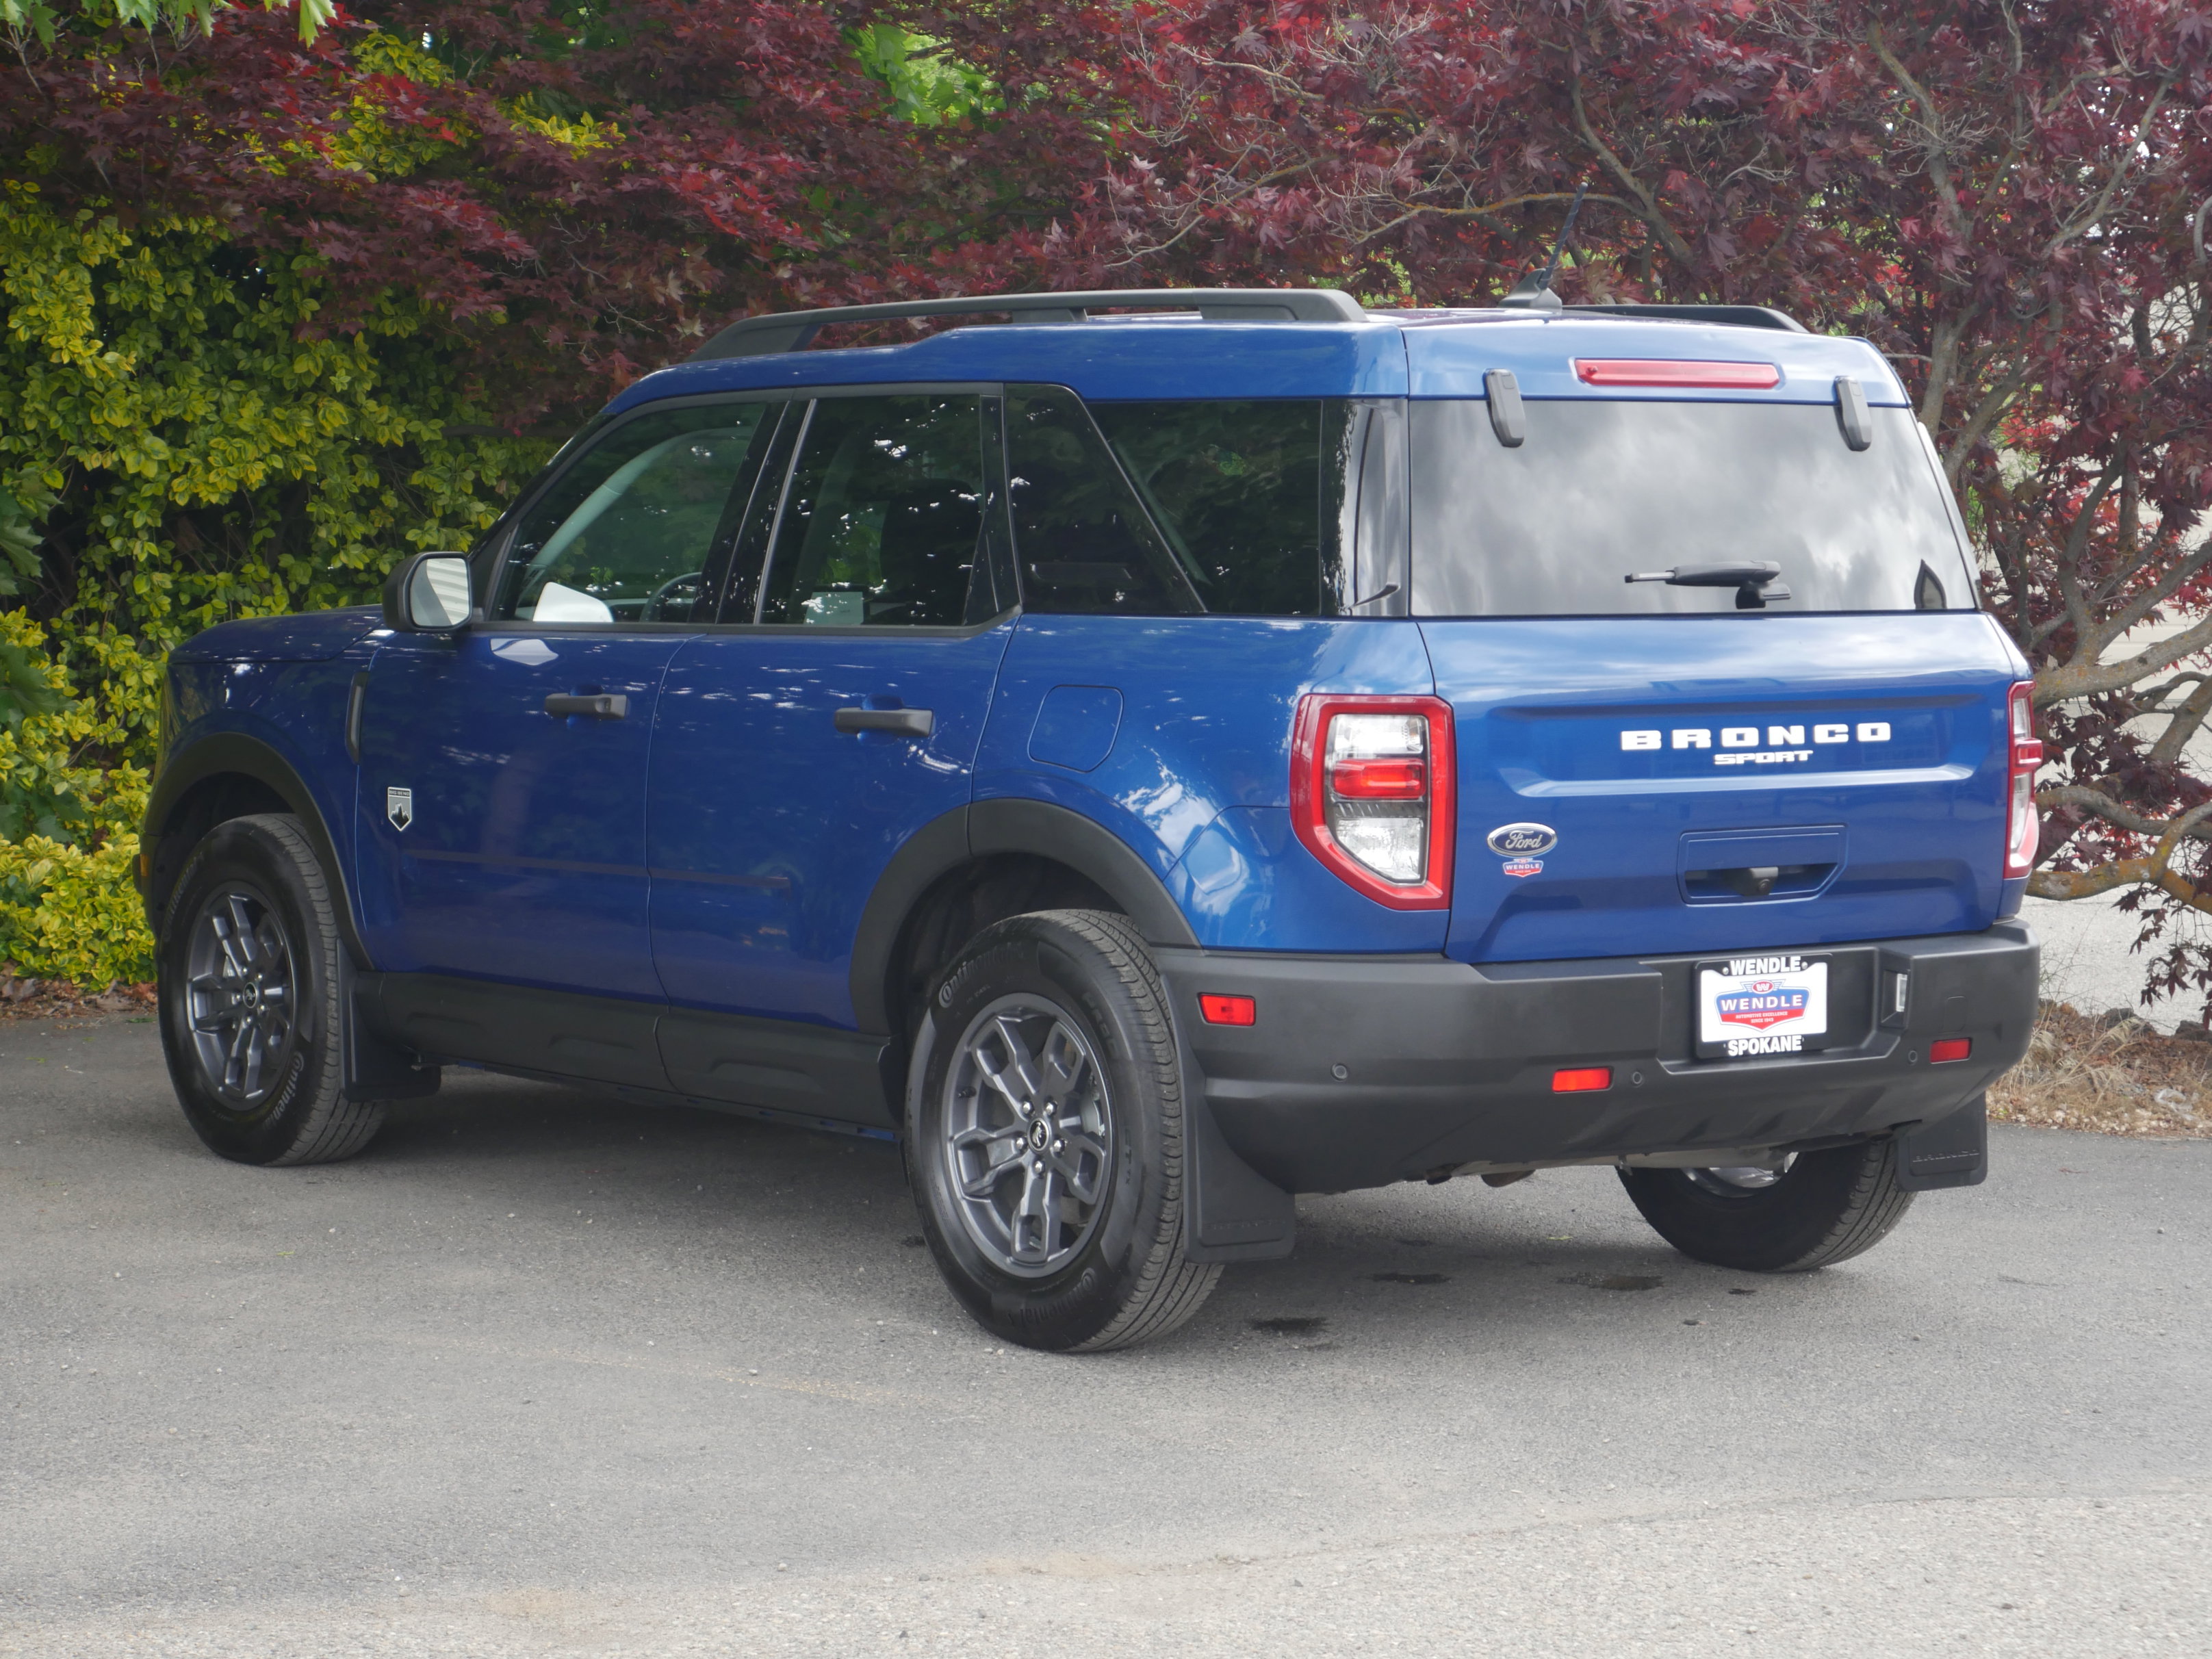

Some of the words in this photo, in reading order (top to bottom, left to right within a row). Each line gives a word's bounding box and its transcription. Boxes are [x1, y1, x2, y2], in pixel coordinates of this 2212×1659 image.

[1620, 722, 1891, 751] BRONCO
[1713, 750, 1814, 765] SPORT
[1506, 830, 1543, 849] Ford
[1729, 956, 1801, 976] WENDLE
[1721, 994, 1803, 1012] WENDLE
[1728, 1035, 1802, 1057] SPOKANE
